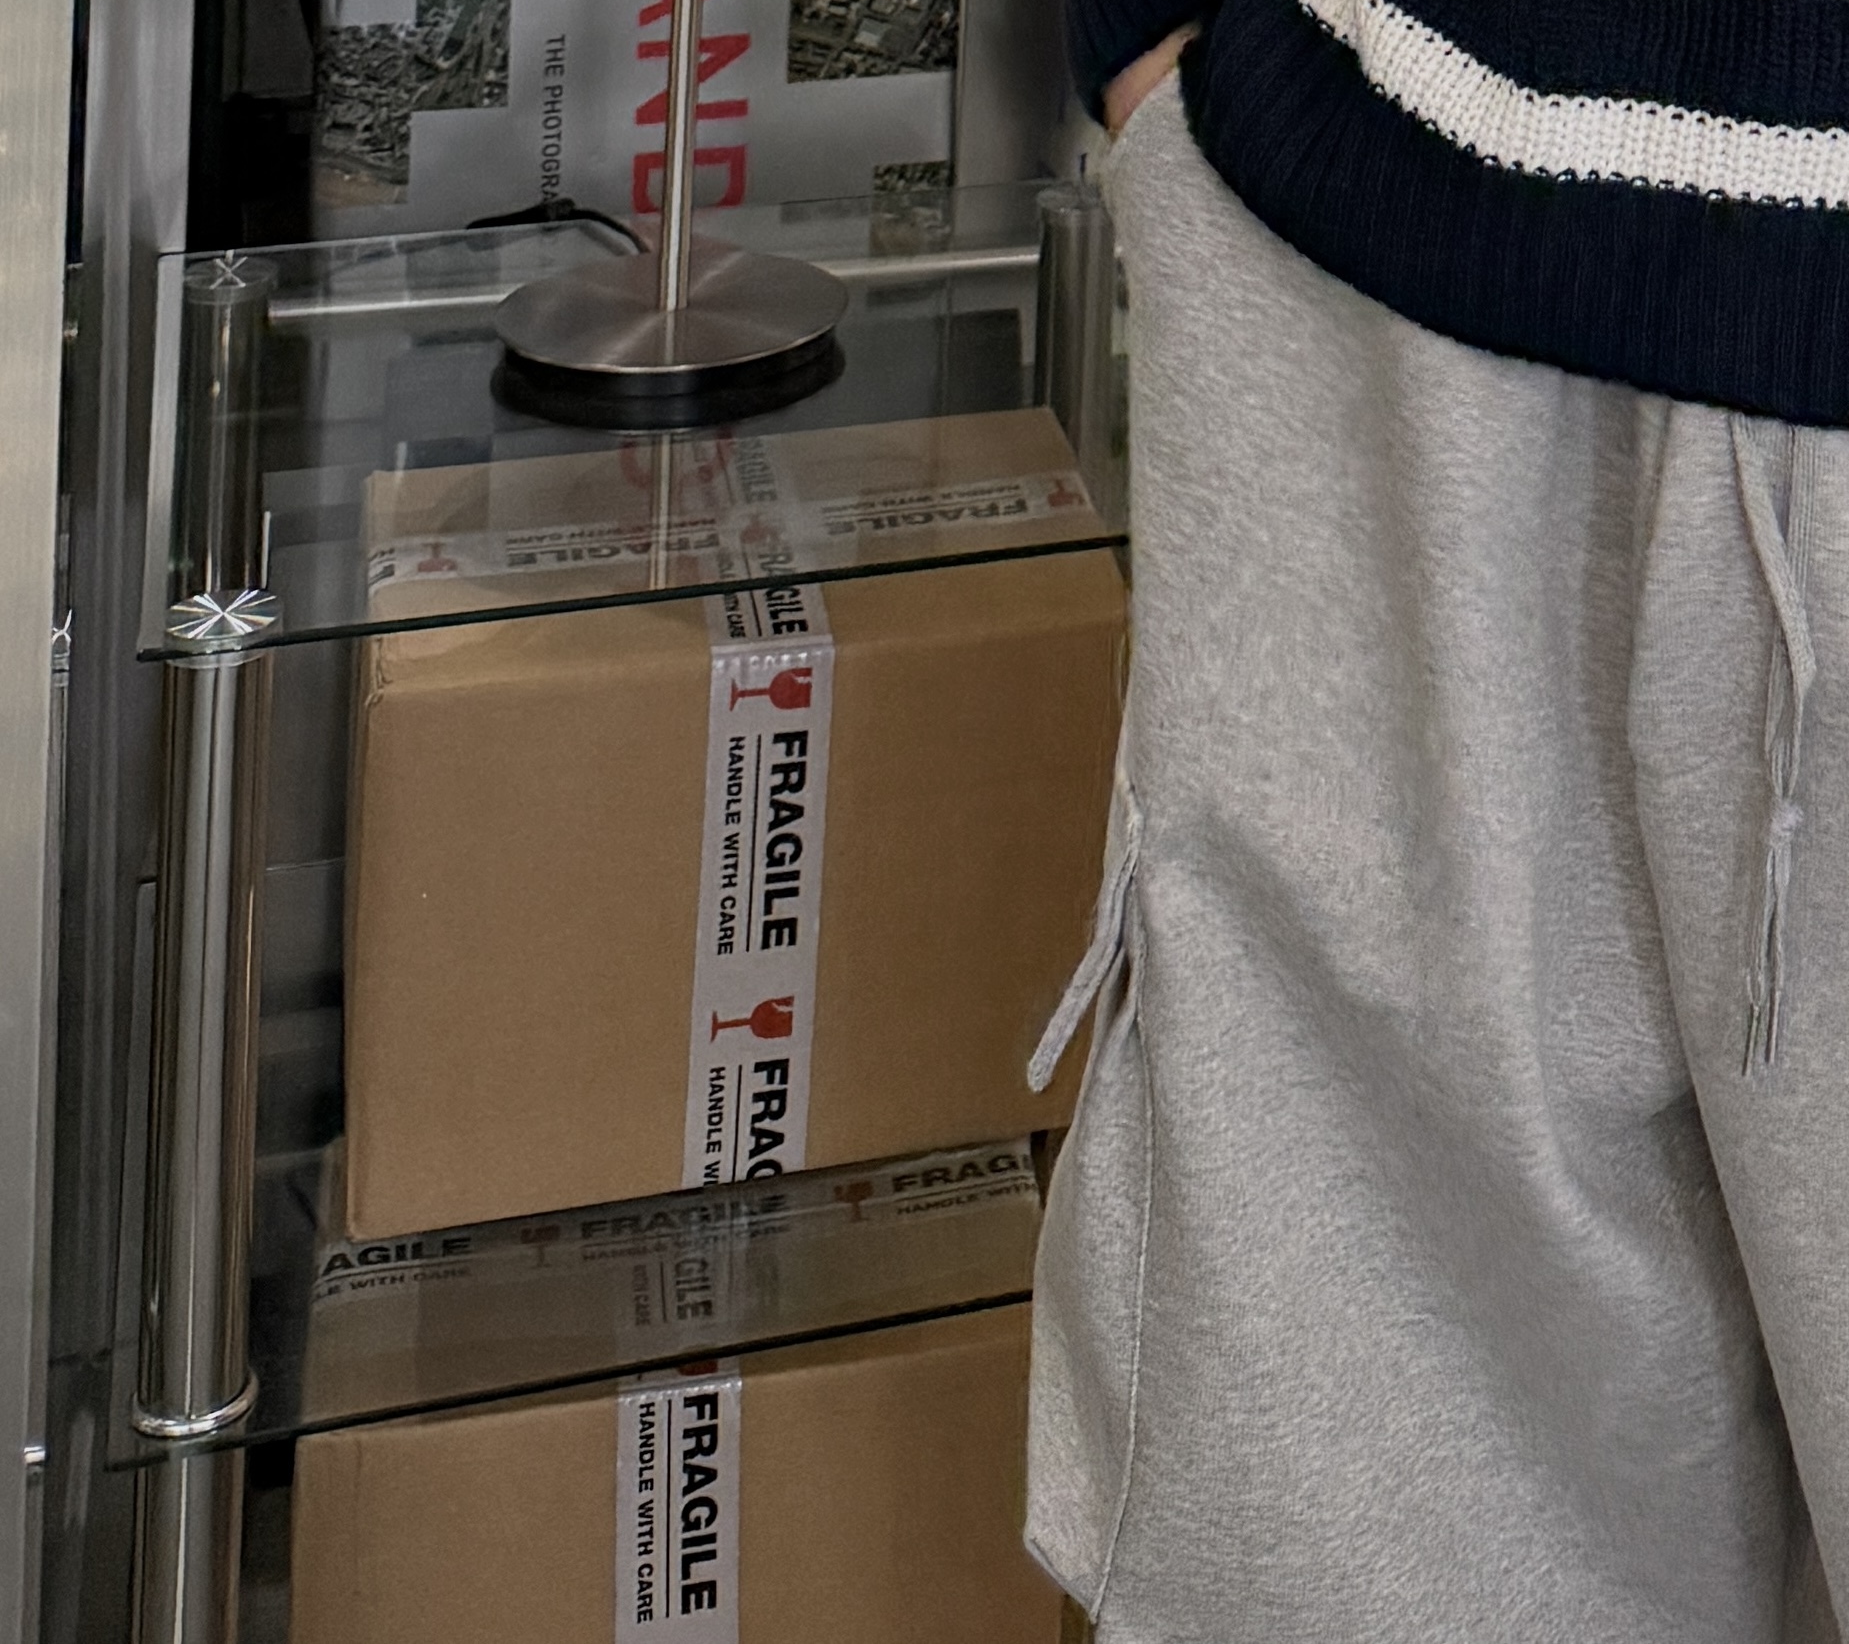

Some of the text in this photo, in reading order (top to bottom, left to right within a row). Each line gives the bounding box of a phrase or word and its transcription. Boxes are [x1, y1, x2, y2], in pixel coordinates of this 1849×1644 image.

[545, 34, 566, 76] THE
[824, 498, 1028, 535] FRAGILE
[717, 736, 746, 956] HANDLE WITH CARE
[760, 730, 808, 950] FRAGILE
[706, 1066, 726, 1154] HANDLE
[350, 1275, 406, 1291] WITH
[636, 1401, 656, 1625] HANDLE WITH CARE
[681, 1392, 719, 1616] FRAGILE
